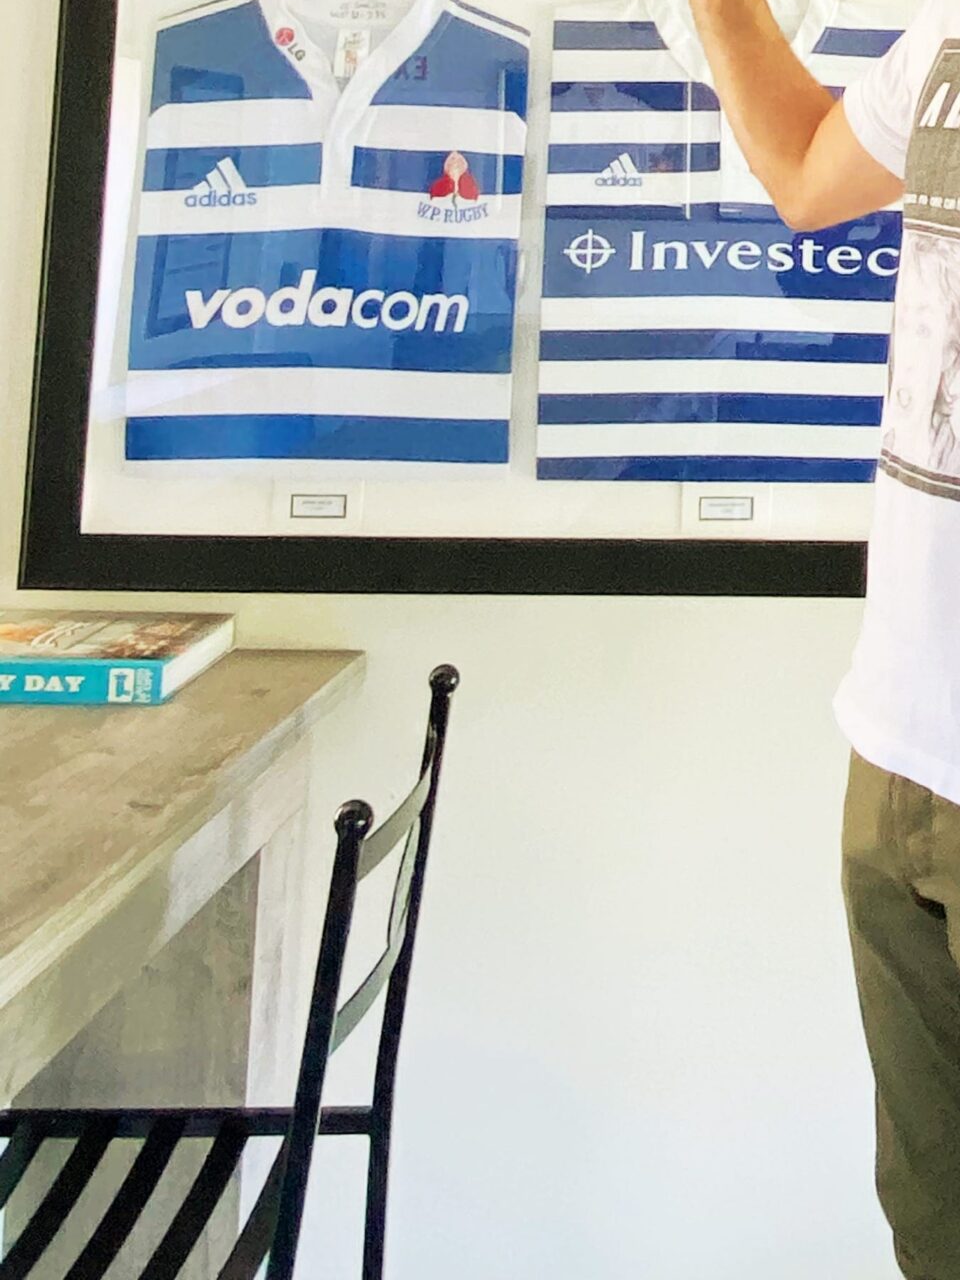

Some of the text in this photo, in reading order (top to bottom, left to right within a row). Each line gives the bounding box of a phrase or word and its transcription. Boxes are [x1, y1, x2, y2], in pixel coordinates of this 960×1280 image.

[287, 42, 306, 62] LG
[595, 176, 642, 187] adidas
[185, 189, 257, 208] adidas
[444, 203, 489, 224] RUGBY
[629, 230, 900, 277] Investec
[185, 269, 469, 333] vodacom
[24, 675, 85, 692] DAY
